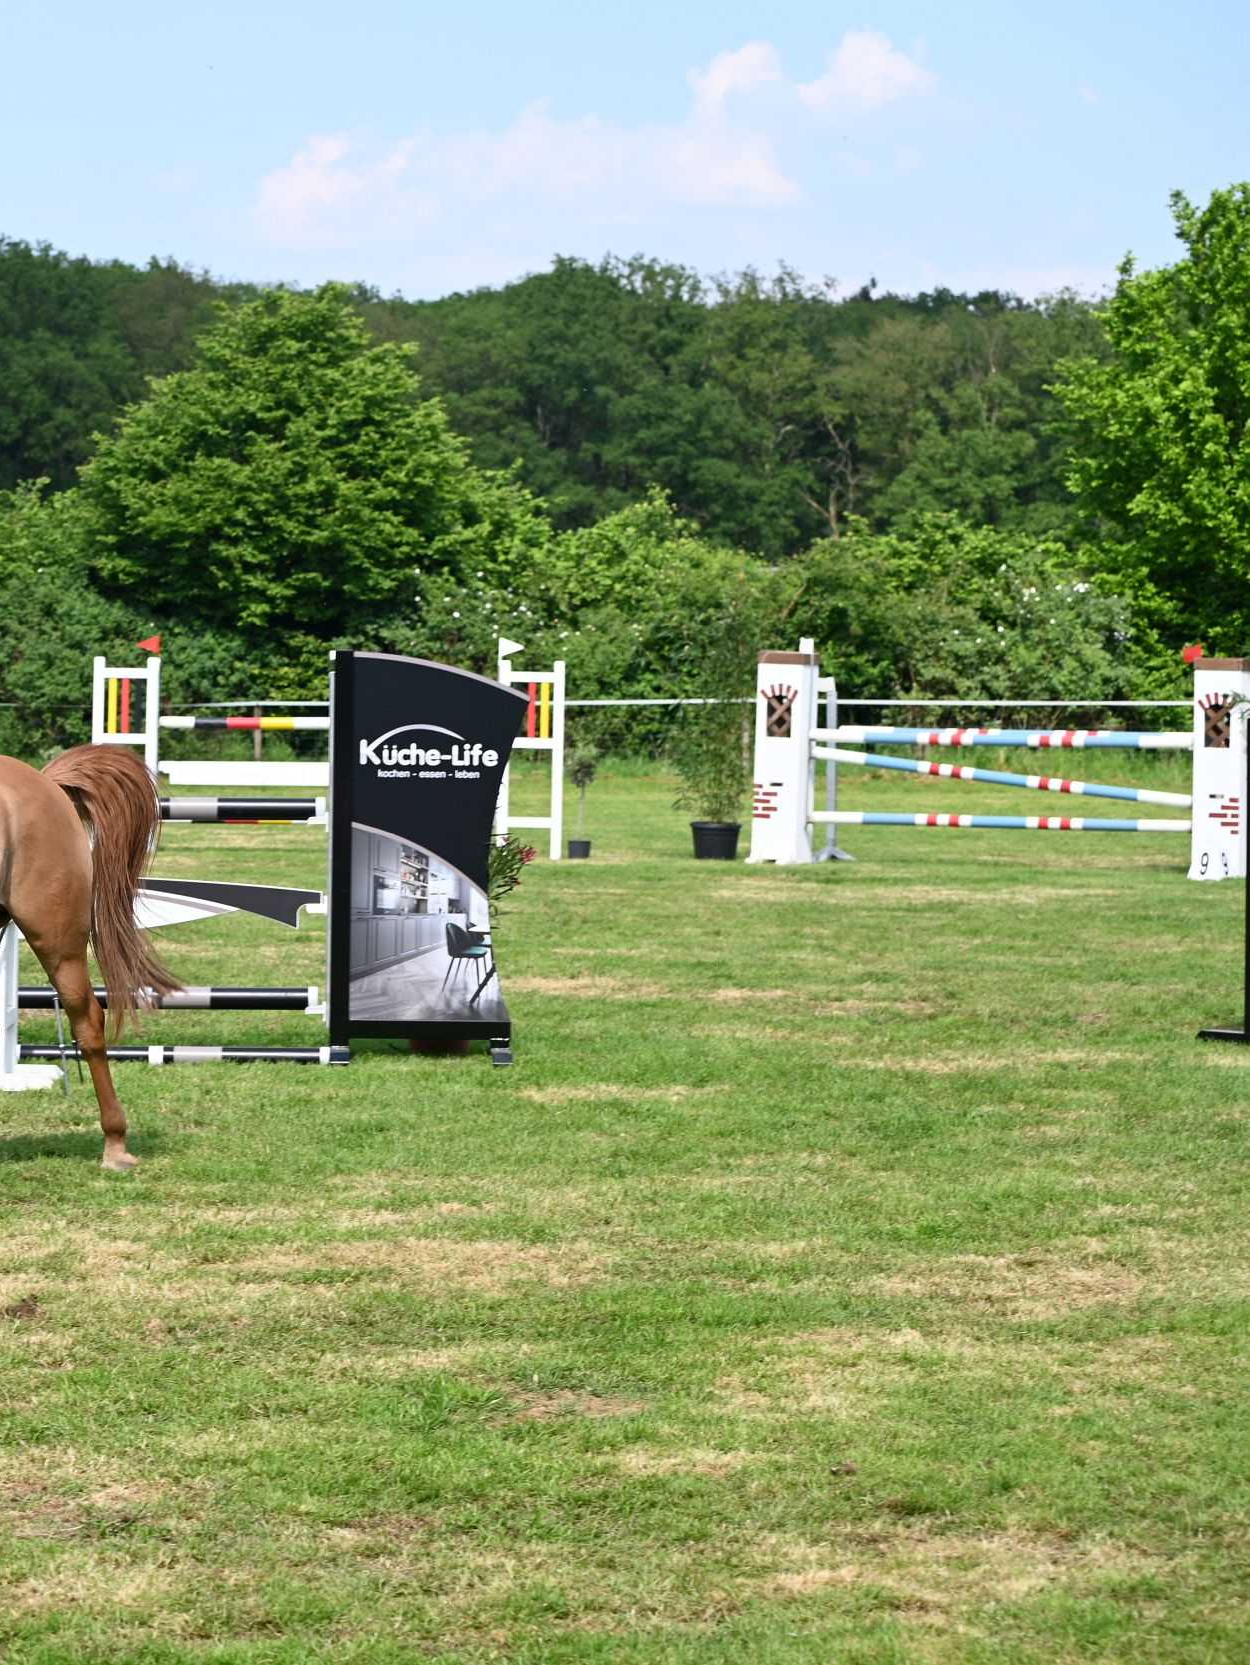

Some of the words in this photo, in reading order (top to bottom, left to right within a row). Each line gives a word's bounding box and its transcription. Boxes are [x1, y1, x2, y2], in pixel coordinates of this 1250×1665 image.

[359, 738, 499, 767] Küche-Life
[377, 768, 411, 778] kochen
[418, 769, 447, 779] essen
[454, 769, 481, 779] leben
